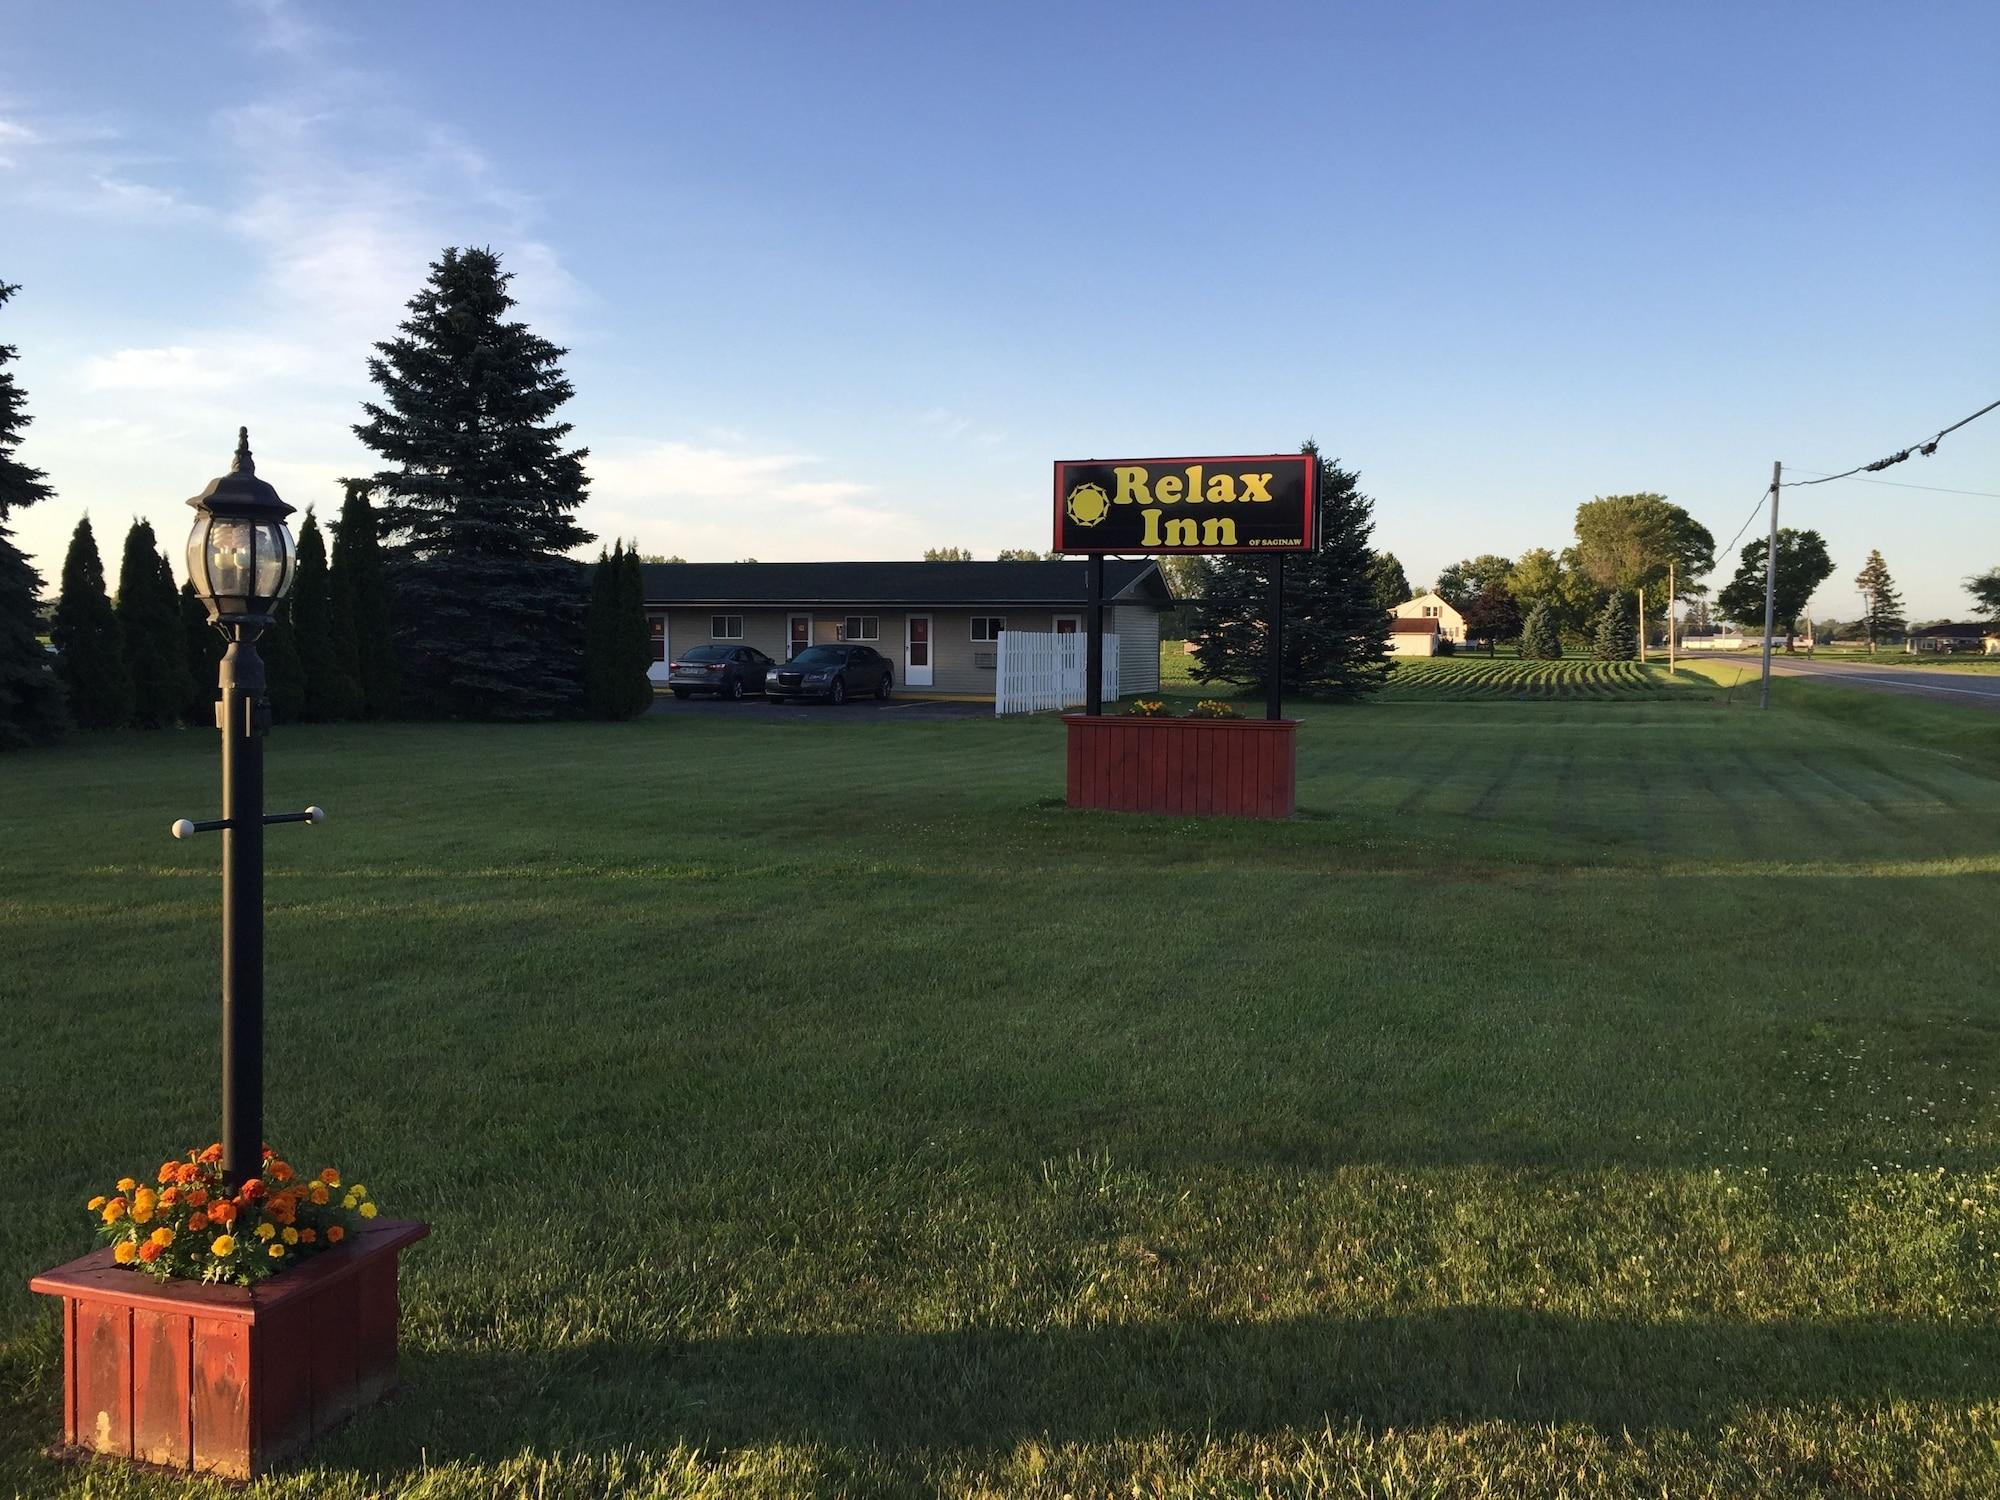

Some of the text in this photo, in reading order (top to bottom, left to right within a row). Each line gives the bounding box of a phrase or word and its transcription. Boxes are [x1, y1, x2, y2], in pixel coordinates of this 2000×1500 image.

[1113, 465, 1273, 505] Relax
[1141, 508, 1239, 546] Inn
[1249, 538, 1302, 547] OF SAGINAW
